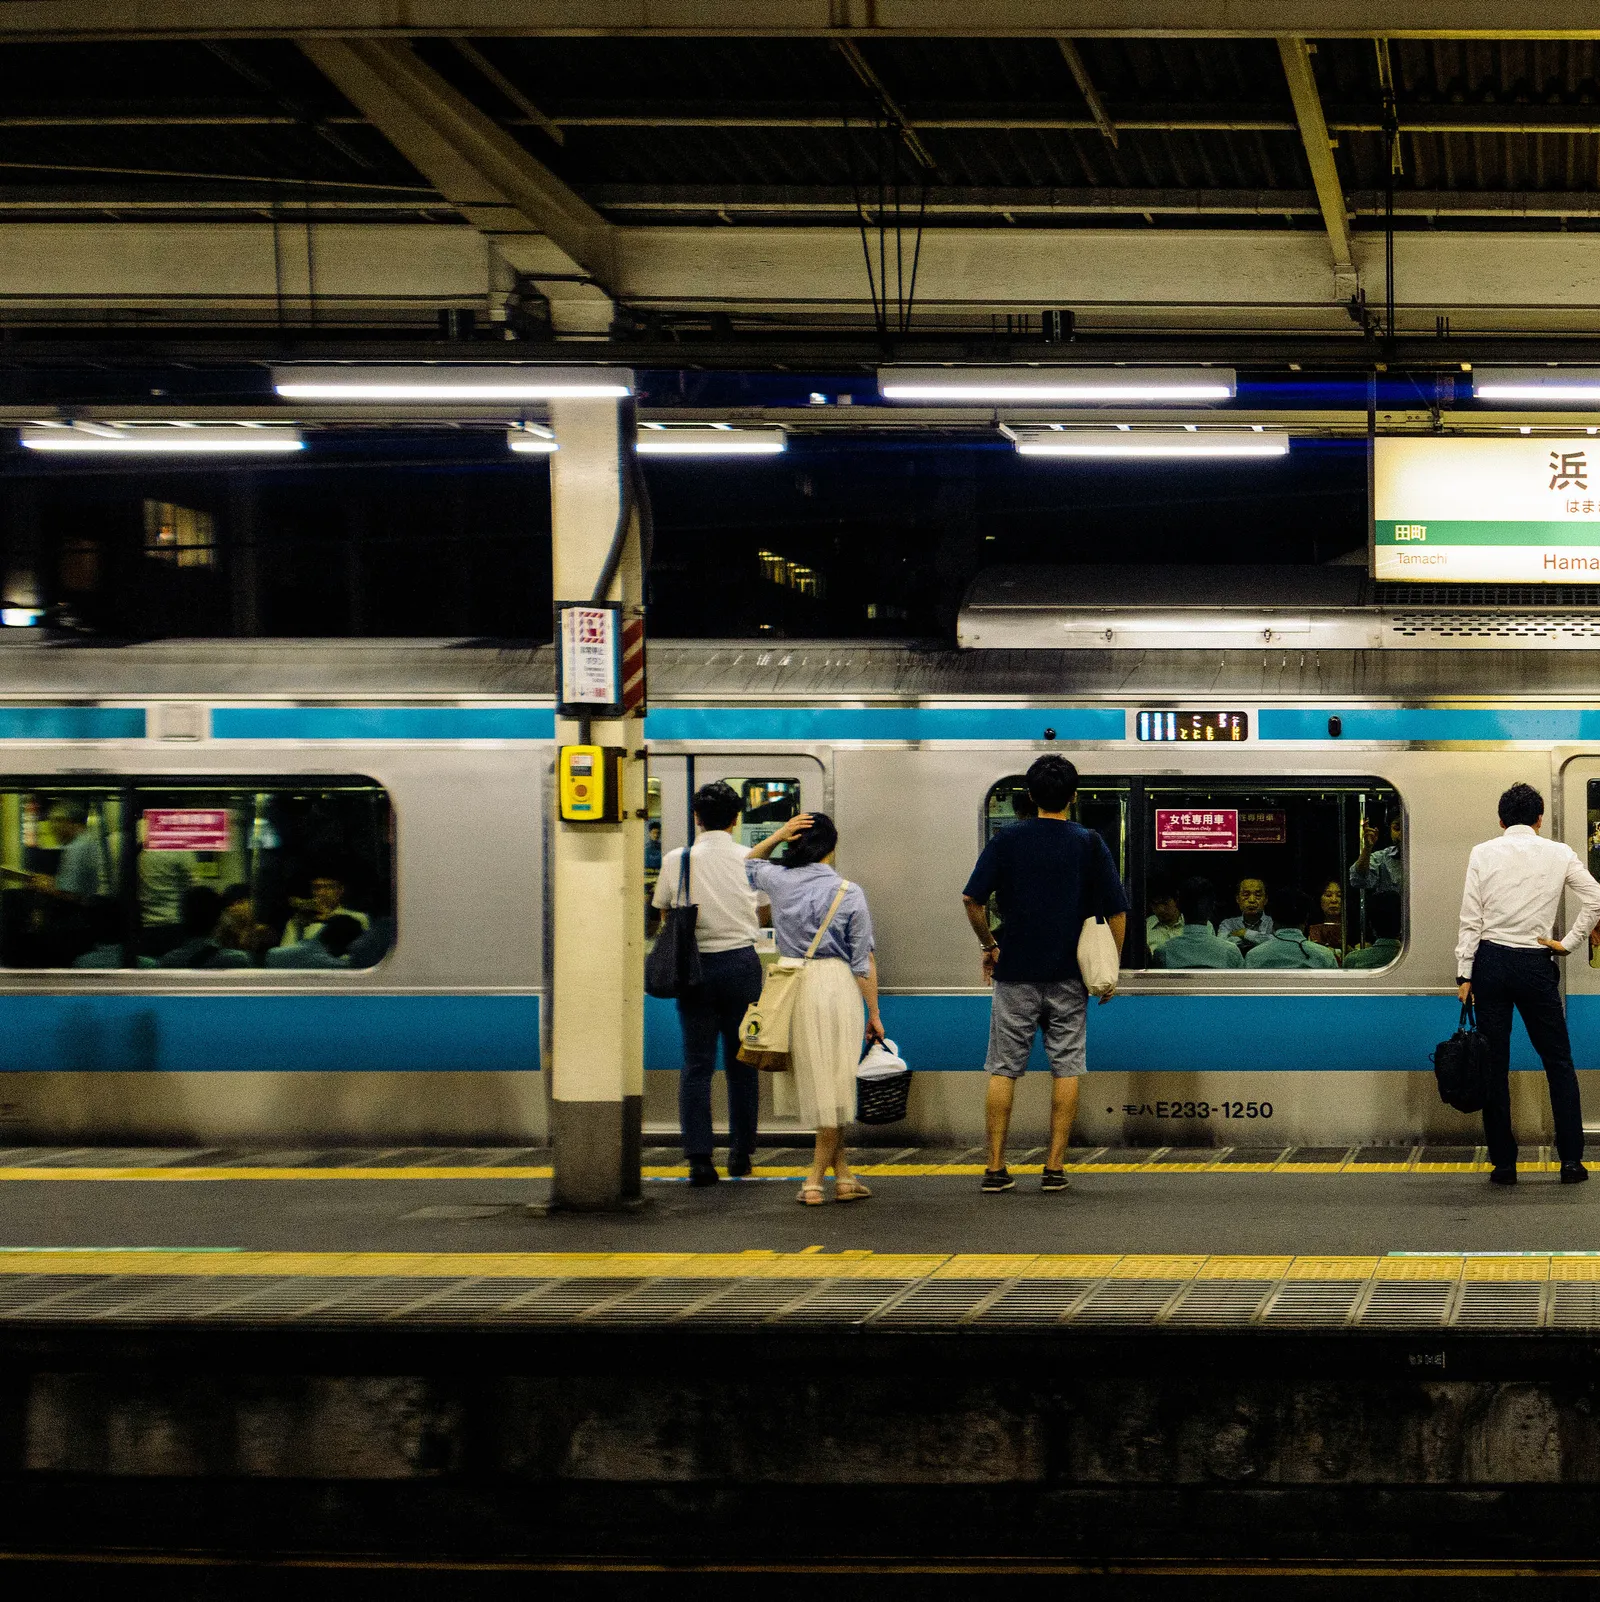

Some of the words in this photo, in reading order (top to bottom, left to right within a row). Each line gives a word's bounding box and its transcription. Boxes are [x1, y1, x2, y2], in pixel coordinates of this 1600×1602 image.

[1394, 525, 1427, 541] 田町
[1397, 552, 1448, 565] Tamachi
[1170, 814, 1225, 825] 女性専用車
